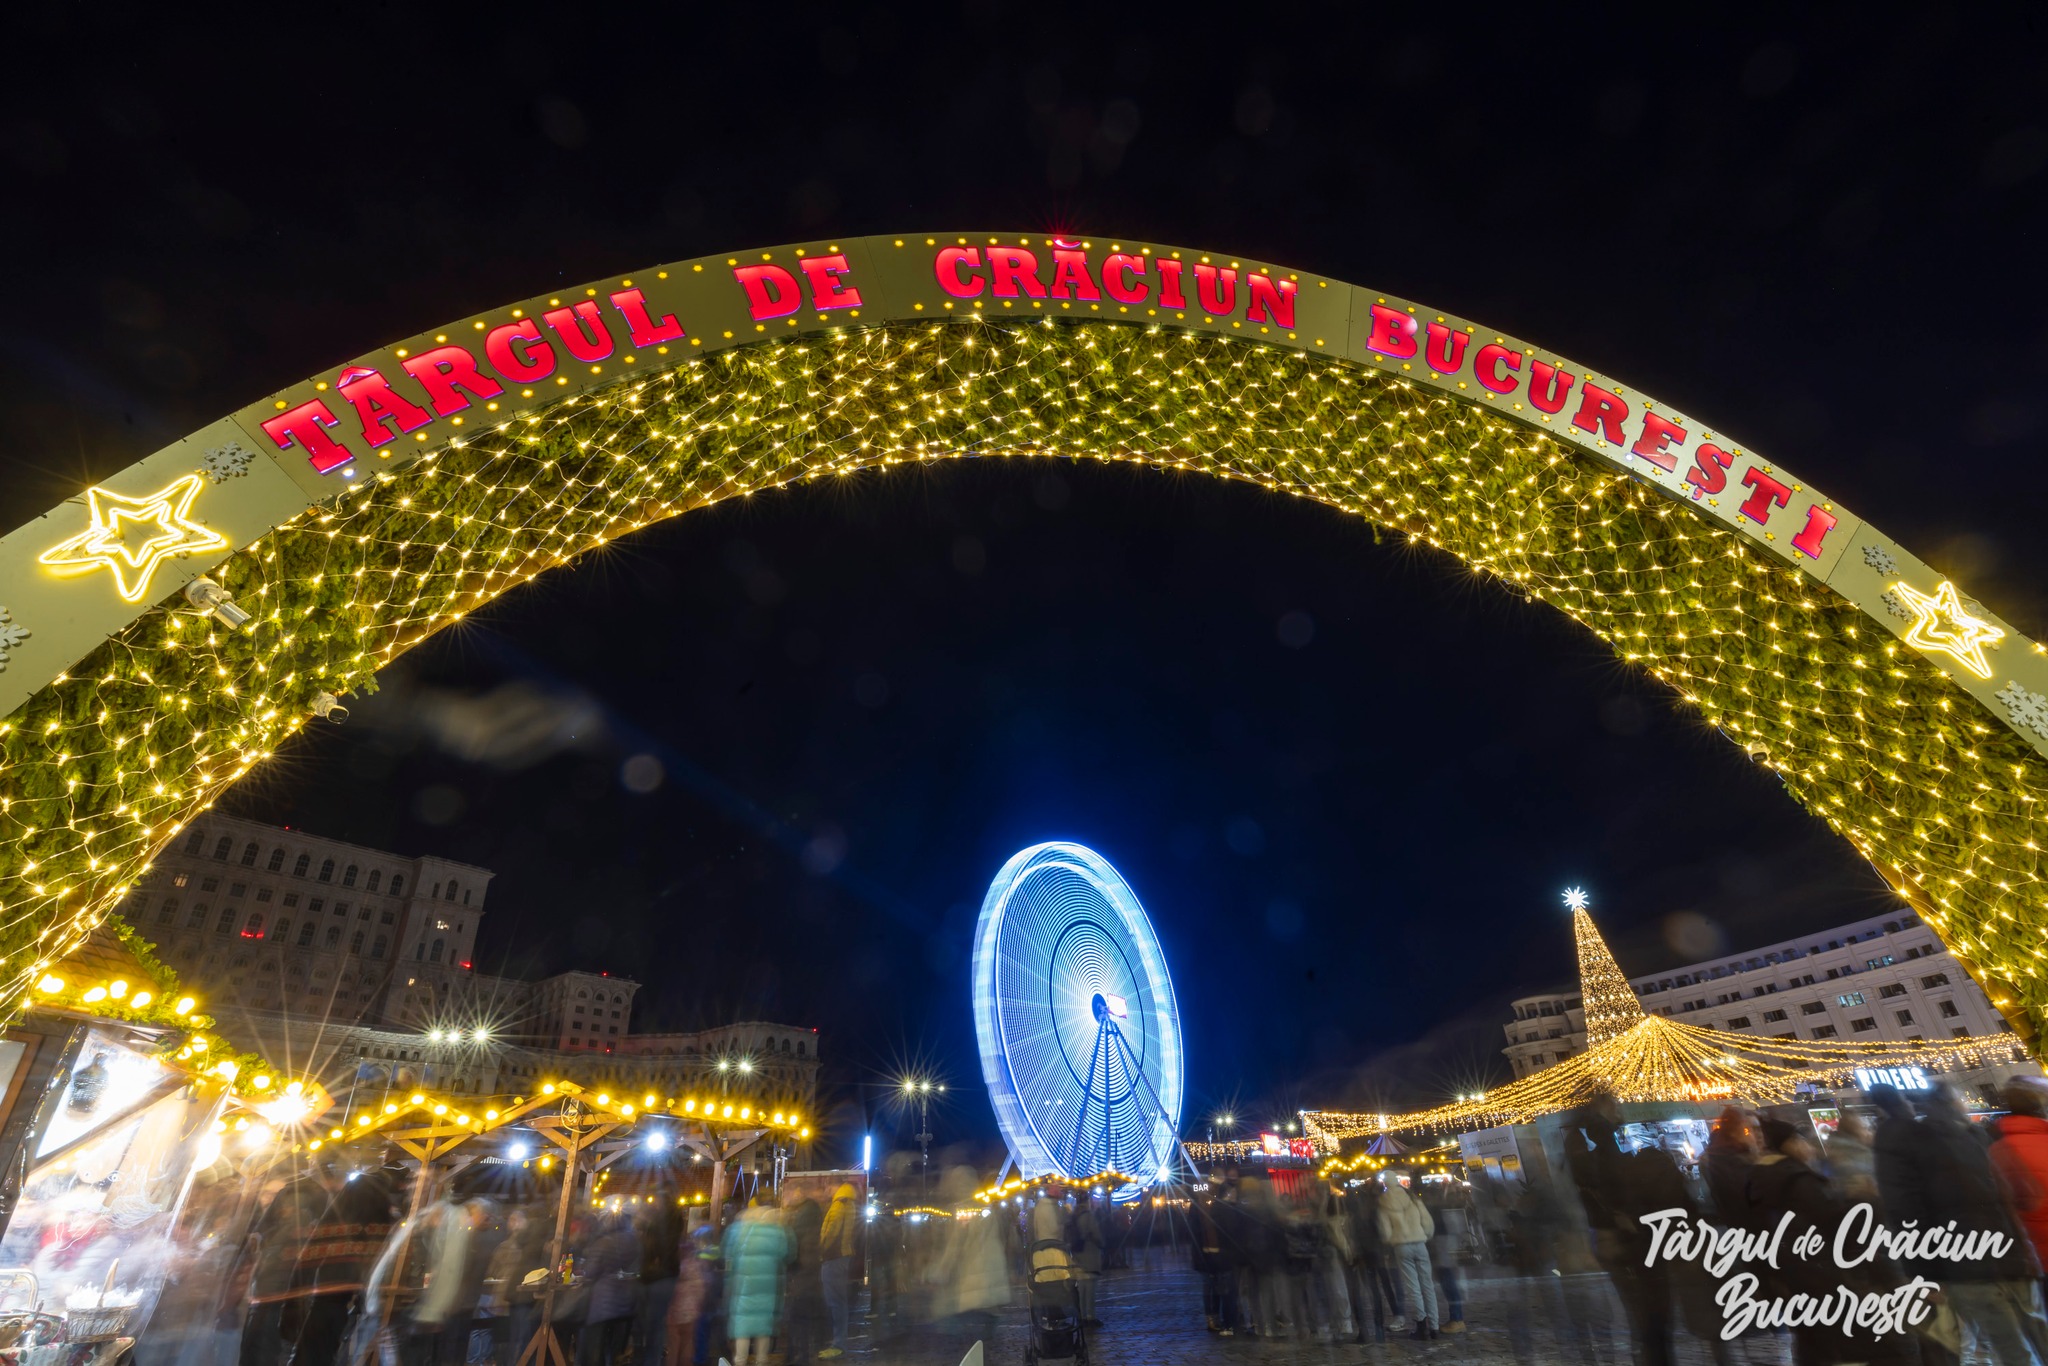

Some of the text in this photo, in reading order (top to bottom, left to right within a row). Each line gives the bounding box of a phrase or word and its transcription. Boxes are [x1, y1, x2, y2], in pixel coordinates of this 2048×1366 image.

[260, 287, 686, 476] TÂRGUL
[733, 253, 863, 321] DE
[933, 238, 1298, 329] CRĂCIUN
[1682, 1083, 1700, 1101] My
[1193, 1183, 1209, 1192] BAR
